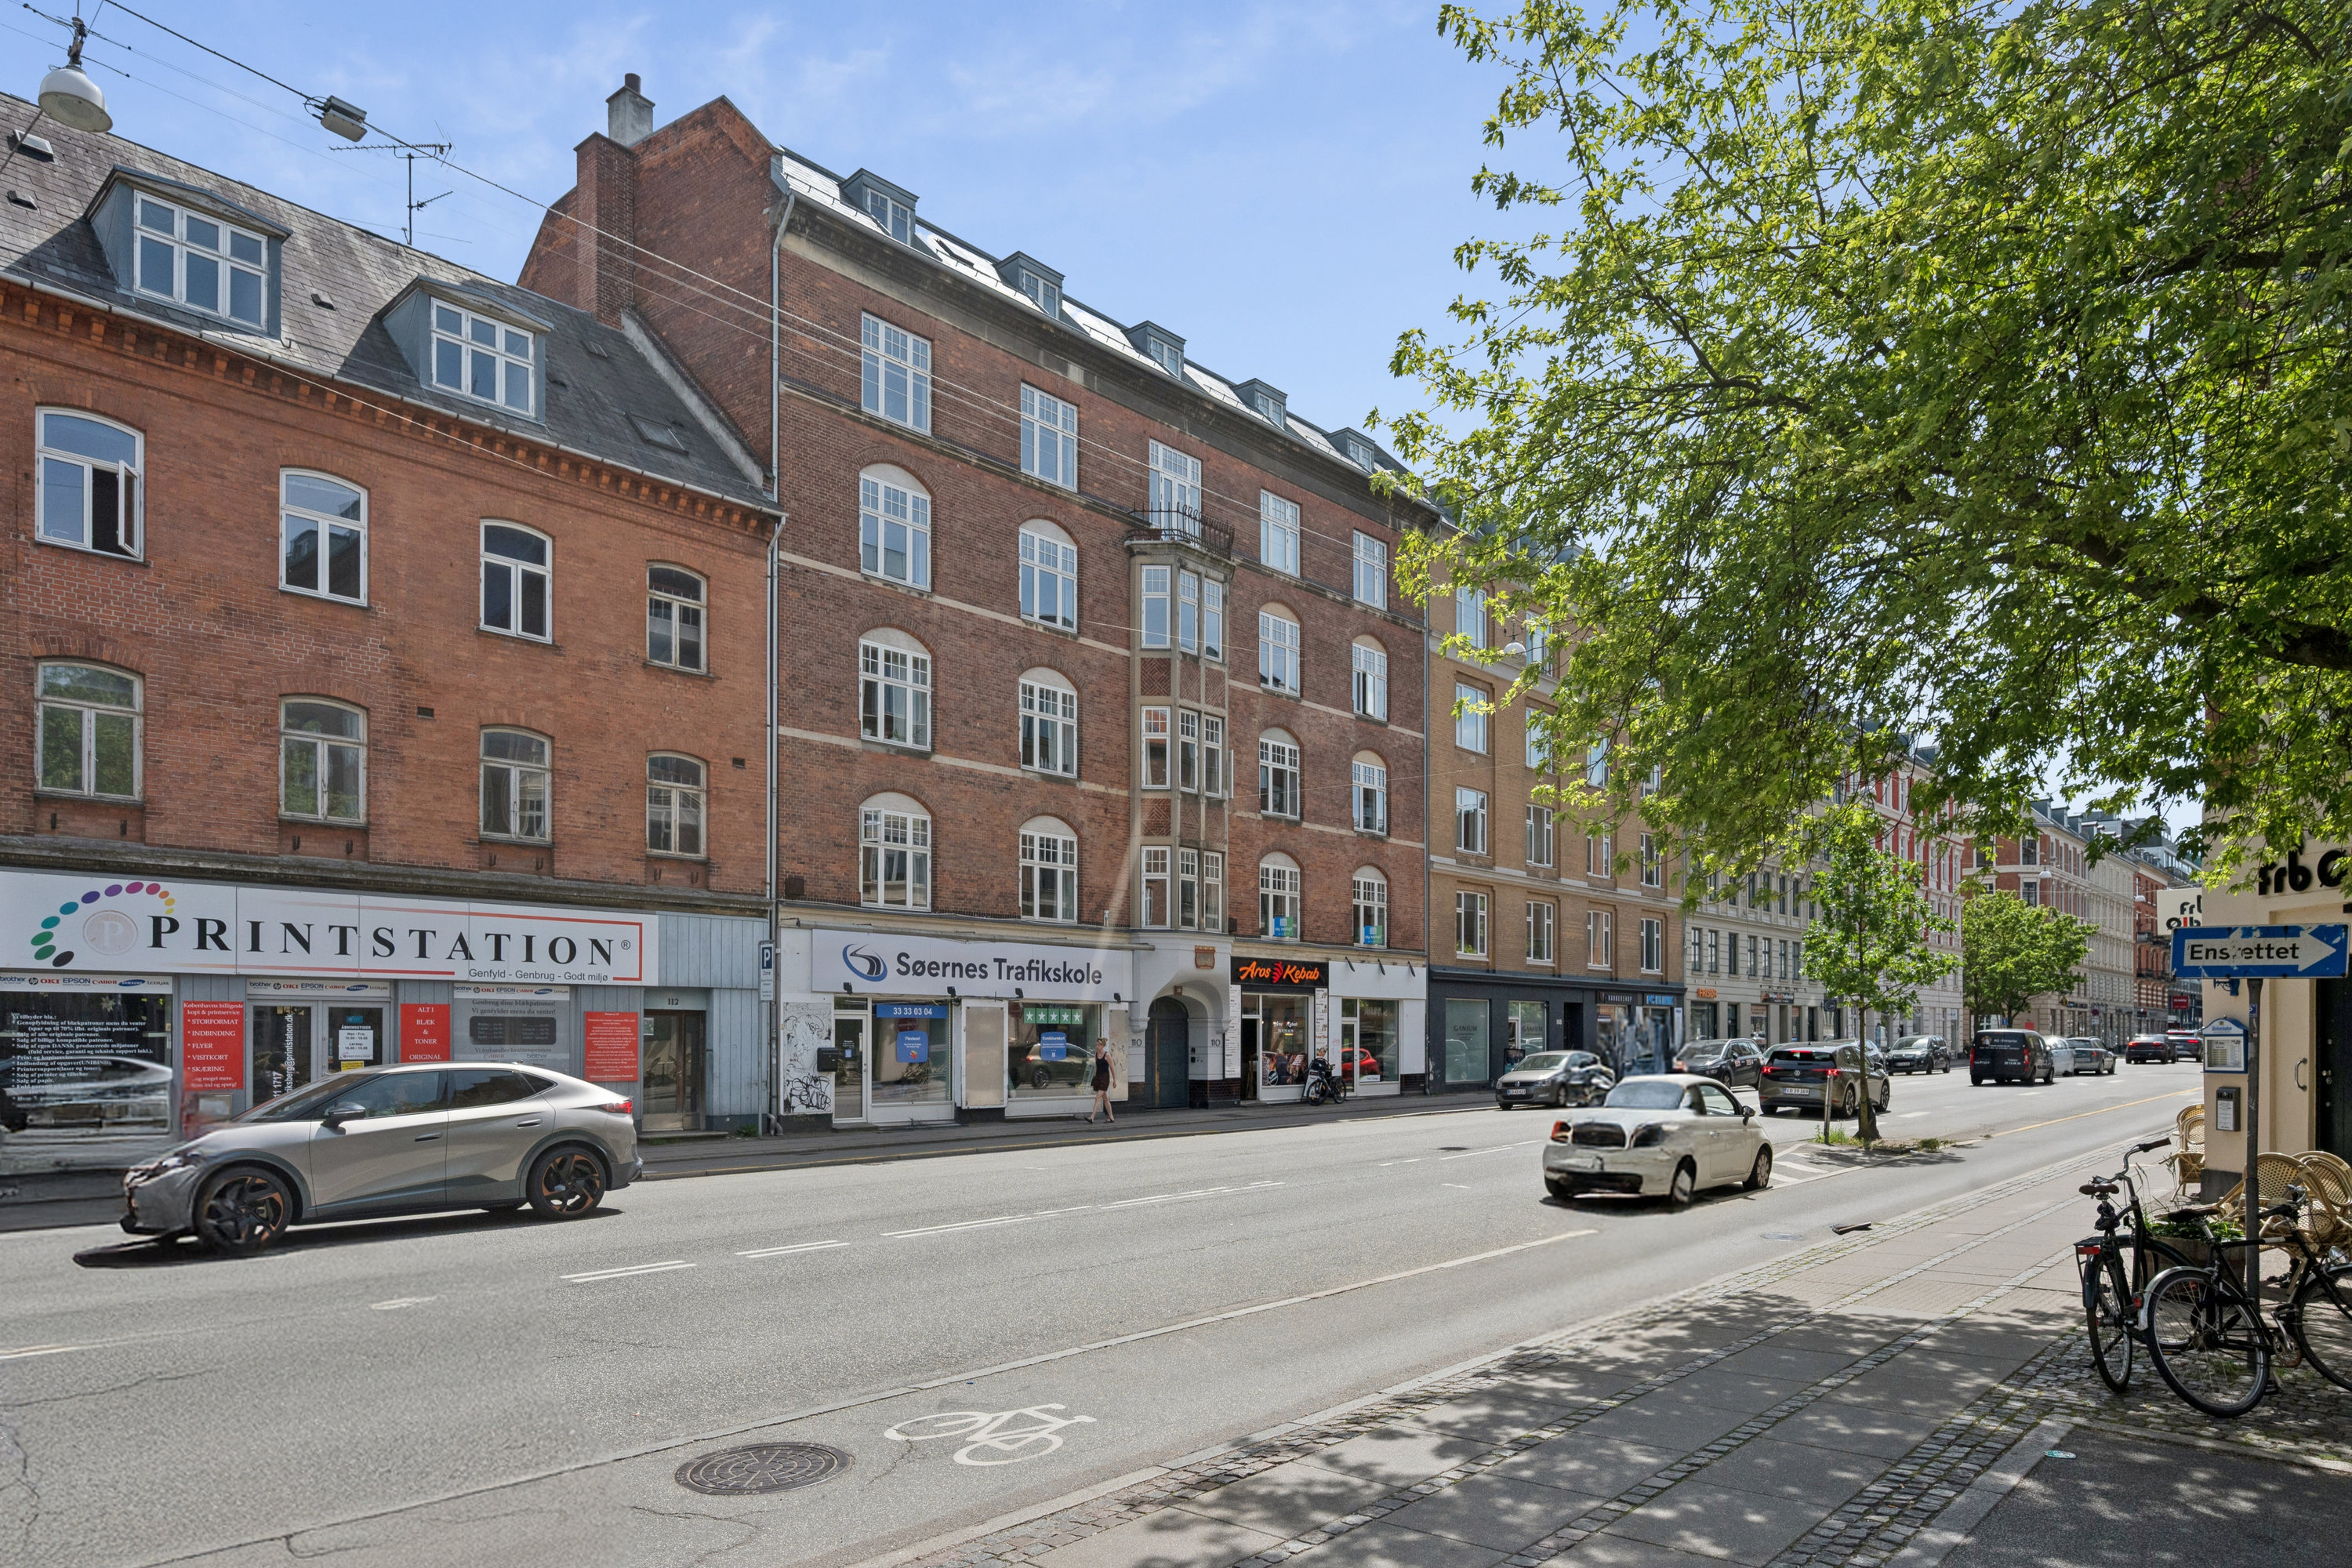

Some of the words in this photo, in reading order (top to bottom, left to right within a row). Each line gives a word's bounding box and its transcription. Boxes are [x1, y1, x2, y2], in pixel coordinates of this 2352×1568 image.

[469, 968, 506, 980] Genfyld
[515, 970, 555, 981] Genbrug
[564, 971, 586, 981] Godt
[588, 973, 608, 982] miljø
[895, 952, 989, 979] Søernes
[993, 957, 1102, 985] Trafikskole
[1240, 961, 1271, 980] Aros
[1283, 965, 1319, 984] Kebab
[1211, 1038, 1221, 1047] 110
